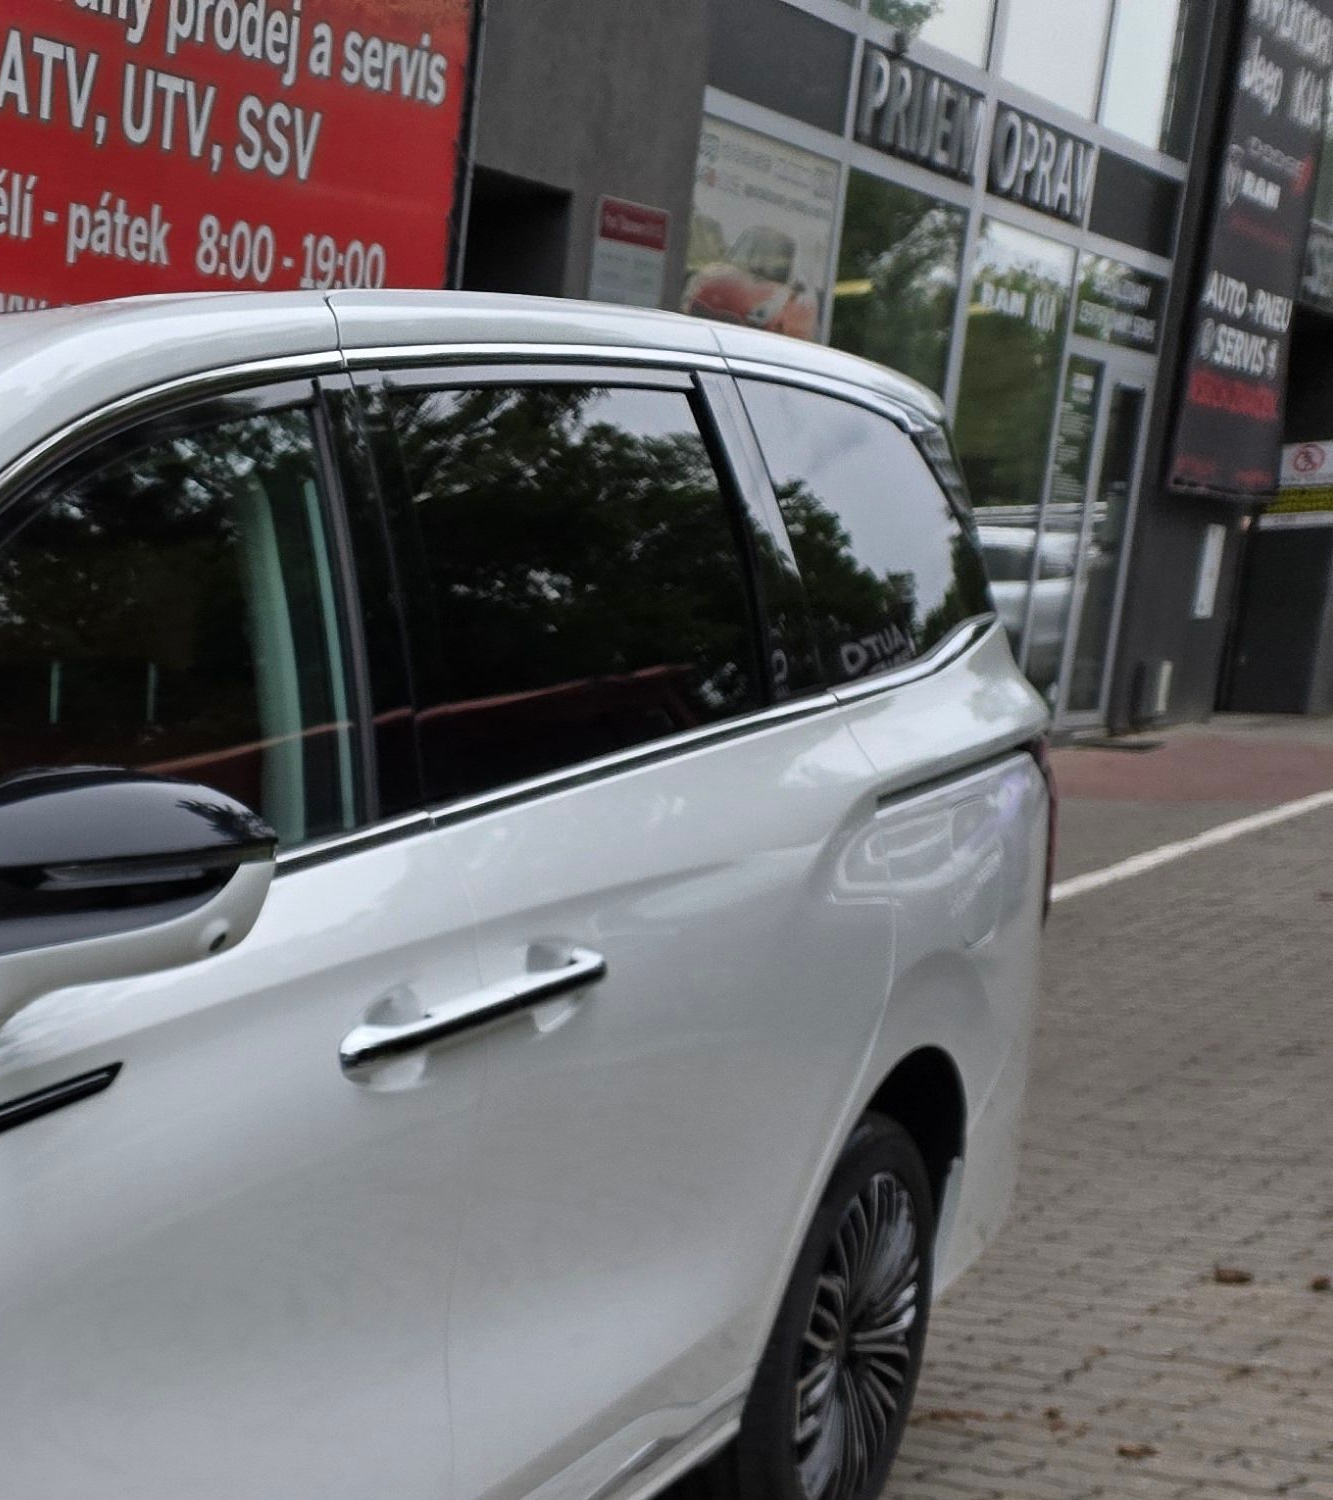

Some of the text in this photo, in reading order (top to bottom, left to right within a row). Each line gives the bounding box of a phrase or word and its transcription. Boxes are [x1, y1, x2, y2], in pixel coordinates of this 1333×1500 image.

[166, 0, 302, 86] prodej
[309, 22, 333, 77] a
[341, 31, 448, 106] servis
[122, 63, 223, 173] UTV,
[235, 94, 323, 181] SSV
[66, 190, 171, 266] pátek
[196, 213, 275, 285] 8:00
[299, 232, 386, 290] 19:00
[1202, 270, 1249, 320] AUTO
[1253, 288, 1293, 333] PNEU
[1213, 323, 1268, 377] SERVIS
